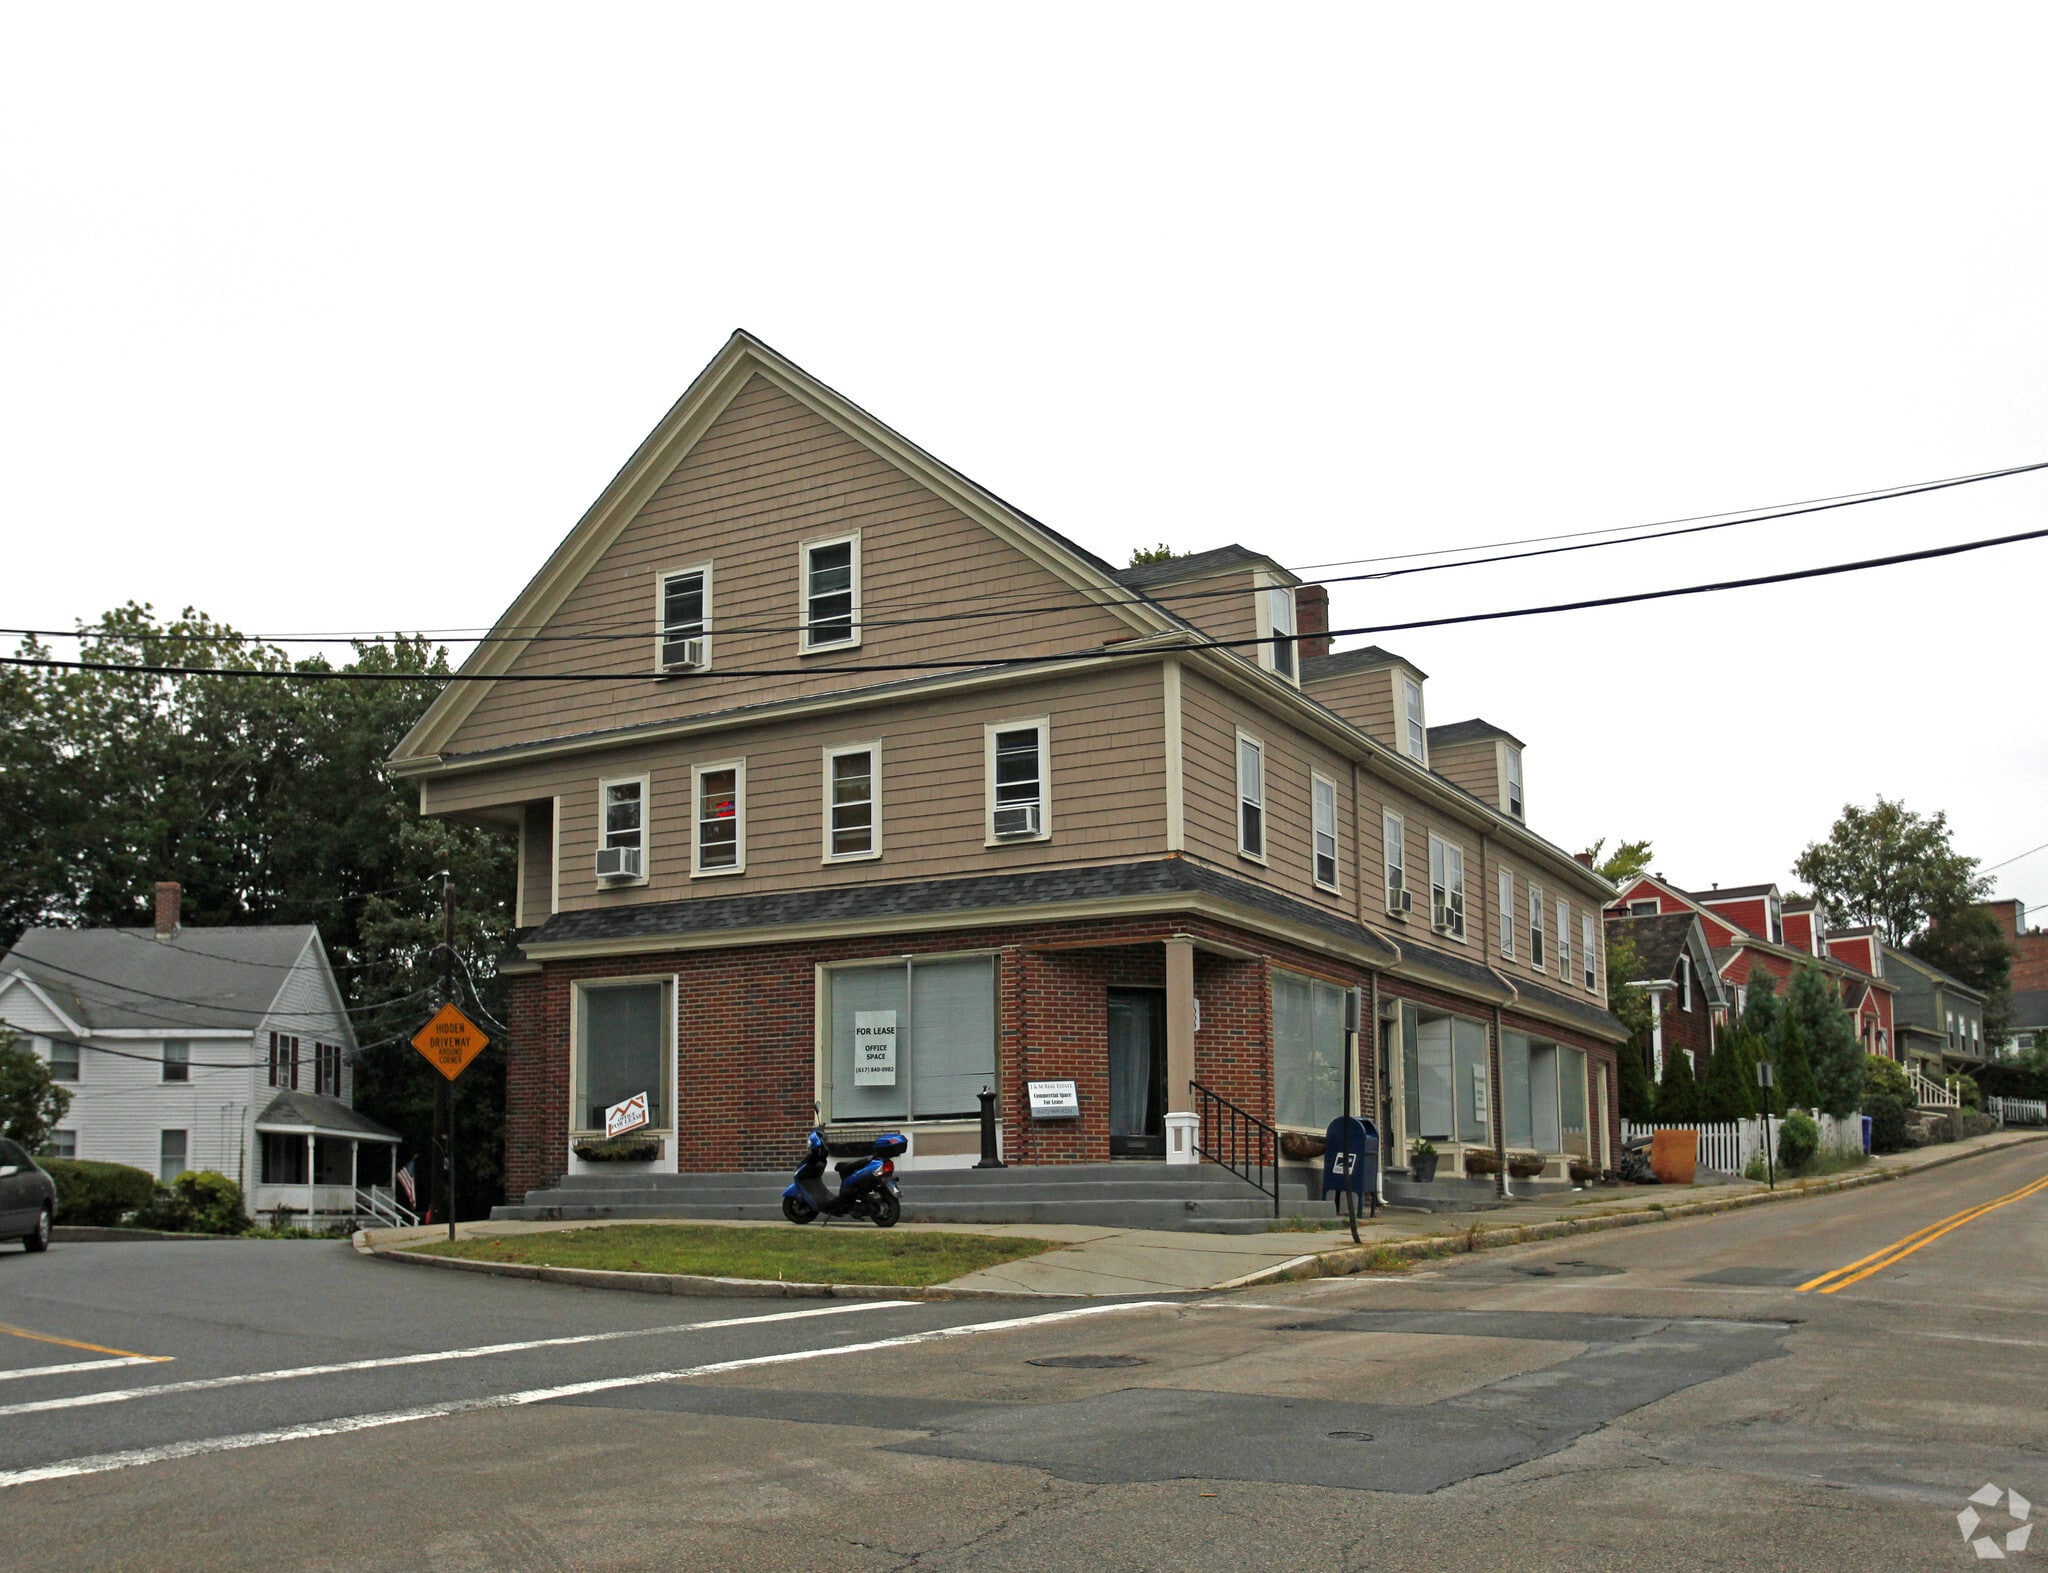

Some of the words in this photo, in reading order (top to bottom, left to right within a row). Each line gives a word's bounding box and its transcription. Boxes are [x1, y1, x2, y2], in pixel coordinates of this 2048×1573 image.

[436, 1023, 465, 1034] HIDDEN
[873, 1027, 895, 1035] LEASE
[429, 1036, 471, 1047] DRIVEWAY
[439, 1056, 463, 1064] CORNER
